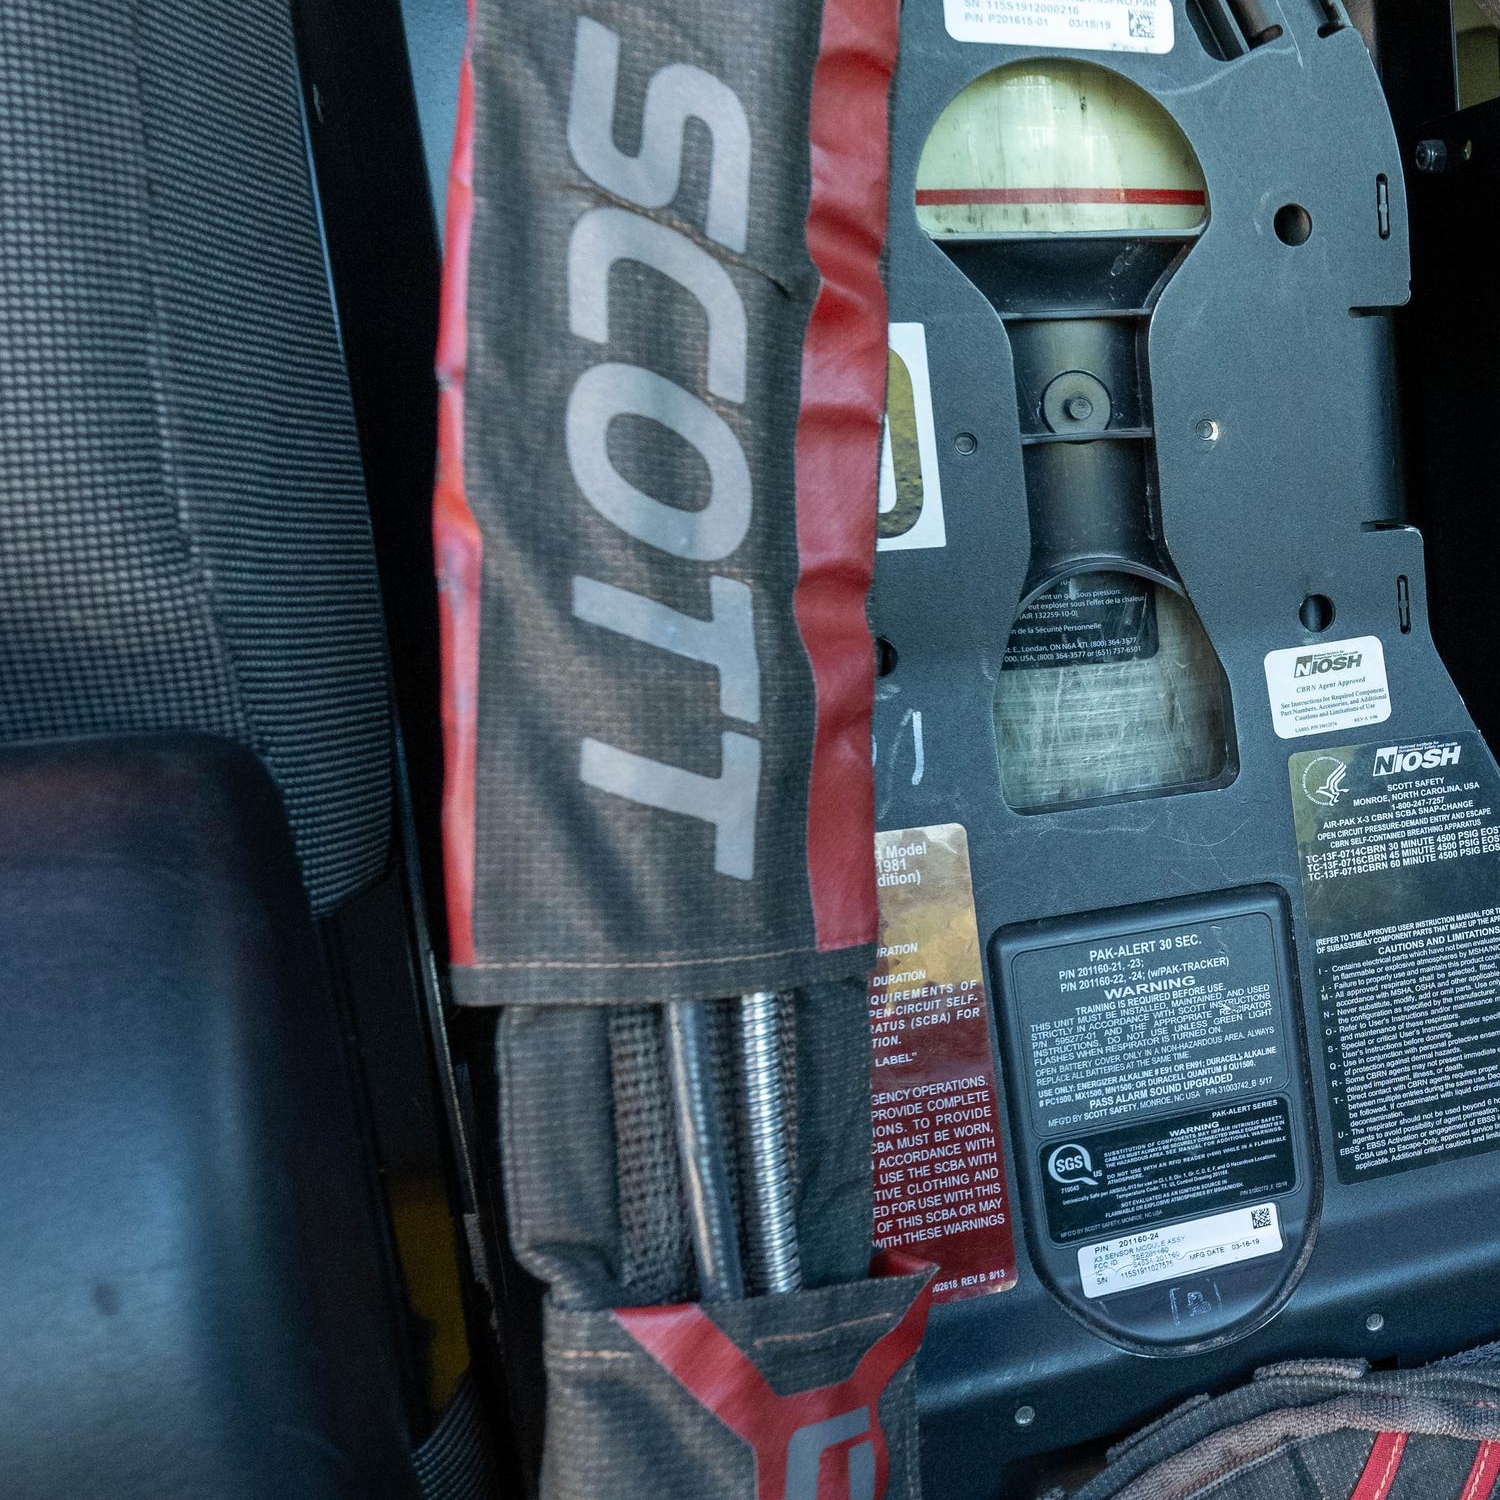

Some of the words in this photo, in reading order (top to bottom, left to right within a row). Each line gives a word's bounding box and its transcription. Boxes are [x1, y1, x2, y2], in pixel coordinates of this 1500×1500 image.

[566, 15, 762, 880] SCOTT
[1063, 622, 1101, 630] Personnelle
[1294, 654, 1363, 678] NIOSH
[1296, 684, 1316, 693] CBRN
[1317, 681, 1336, 691] Agent
[1337, 676, 1366, 688] Approved
[1373, 746, 1462, 777] NIOSH
[1353, 794, 1390, 807] MONROE,
[1391, 790, 1418, 801] NORTH
[1420, 784, 1462, 797] CAROLINA,
[1463, 782, 1479, 790] USA
[1387, 781, 1413, 791] SCOTT
[1414, 777, 1444, 788] SAFETY
[1322, 817, 1355, 829] AIR-PAK
[1356, 815, 1369, 824] X-3
[1370, 812, 1393, 822] CBRN
[1395, 808, 1416, 818] SCBA
[1418, 800, 1473, 815] SNAP-CHANGE
[1391, 796, 1444, 810] 1-800-247-7257
[1317, 831, 1336, 840] OPEN
[1337, 827, 1362, 838] CIRCUIT
[1364, 817, 1428, 833] PRESSURE-DEMAND
[1429, 814, 1450, 823] ENTRY
[1450, 811, 1464, 820] AND
[1465, 807, 1490, 818] ESCAPE
[1330, 839, 1349, 848] CBRN
[1350, 830, 1405, 845] SELF-CONTAINED
[1406, 824, 1443, 836] BREATHING
[1443, 818, 1480, 830] APPARATUS
[886, 843, 926, 858] Model
[1306, 844, 1386, 864] TC-13F-0714CBRN
[1388, 842, 1398, 851] 30
[1400, 836, 1434, 849] MINUTE
[1436, 832, 1456, 843] 4500
[1457, 829, 1478, 840] PSIG
[1307, 852, 1387, 872] TC-13F-0716CBRN
[1388, 850, 1399, 860] 45
[1401, 845, 1435, 857] MINUTE
[1437, 841, 1457, 852] 4500
[1458, 838, 1479, 848] PSIG
[1308, 861, 1388, 881] TC-13F-0718CBRN
[1389, 859, 1400, 868] 60
[1402, 853, 1436, 866] MINUTE
[1438, 850, 1458, 860] 4500
[1459, 846, 1480, 857] PSIG
[1089, 942, 1154, 962] PAK-ALERT
[1158, 939, 1172, 951] 30
[1174, 934, 1201, 948] SEC.
[1377, 938, 1424, 955] CAUTIONS
[1425, 935, 1445, 946] AND
[1446, 925, 1500, 942] LIMITATIONS
[872, 970, 926, 987] DURATION
[1058, 969, 1075, 980] P/N
[1077, 961, 1124, 978] 201160-21,
[1126, 958, 1144, 970] -23;
[1060, 981, 1076, 992] P/N
[1078, 974, 1126, 990] 201160-22,
[1128, 970, 1145, 982] -24;
[1147, 957, 1229, 979] (w/PAK-TRACKER)
[960, 980, 976, 992] OF
[1075, 1000, 1115, 1015] TRAINING
[1117, 998, 1125, 1008] IS
[1127, 991, 1170, 1006] REQUIRED
[1171, 985, 1206, 999] BEFORE
[1206, 981, 1225, 993] USE.
[1104, 976, 1195, 1000] WARNING
[946, 994, 978, 1008] SELF-
[909, 1010, 951, 1029] (SCBA)
[955, 1006, 980, 1020] FOR
[874, 1052, 917, 1067] LABEL"
[912, 1075, 987, 1098] OPERATIONS.
[1089, 1095, 1113, 1109] PASS
[1114, 1089, 1148, 1104] ALARM
[1149, 1082, 1182, 1097] SOUND
[1183, 1072, 1233, 1091] UPGRADED
[926, 1091, 989, 1112] COMPLETE
[1211, 1104, 1251, 1118] PAK-ALERT
[1252, 1100, 1277, 1111] SERIES
[914, 1117, 930, 1130] TO
[935, 1106, 991, 1126] PROVIDE
[1168, 1120, 1219, 1137] WARNING
[896, 1134, 928, 1149] MUST
[933, 1130, 949, 1142] BE
[953, 1122, 993, 1140] WORN,
[877, 1143, 961, 1169] ACCORDANCE
[965, 1137, 995, 1152] WITH
[1056, 1156, 1083, 1173] SGS
[879, 1170, 904, 1184] USE
[908, 1165, 930, 1179] THE
[933, 1159, 966, 1174] SCBA
[967, 1153, 997, 1168] WITH
[906, 1173, 969, 1195] CLOTHING
[972, 1168, 999, 1182] AND
[890, 1200, 916, 1214] FOR
[917, 1195, 942, 1209] USE
[943, 1188, 973, 1204] WITH
[976, 1183, 1001, 1198] THIS
[876, 1220, 893, 1233] OF
[896, 1214, 923, 1229] THIS
[924, 1207, 957, 1223] SCBA
[958, 1203, 976, 1216] OR
[978, 1198, 1002, 1212] MAY
[903, 1225, 942, 1243] THESE
[943, 1213, 1005, 1235] WARNINGS
[1118, 1233, 1159, 1248] 201160-24
